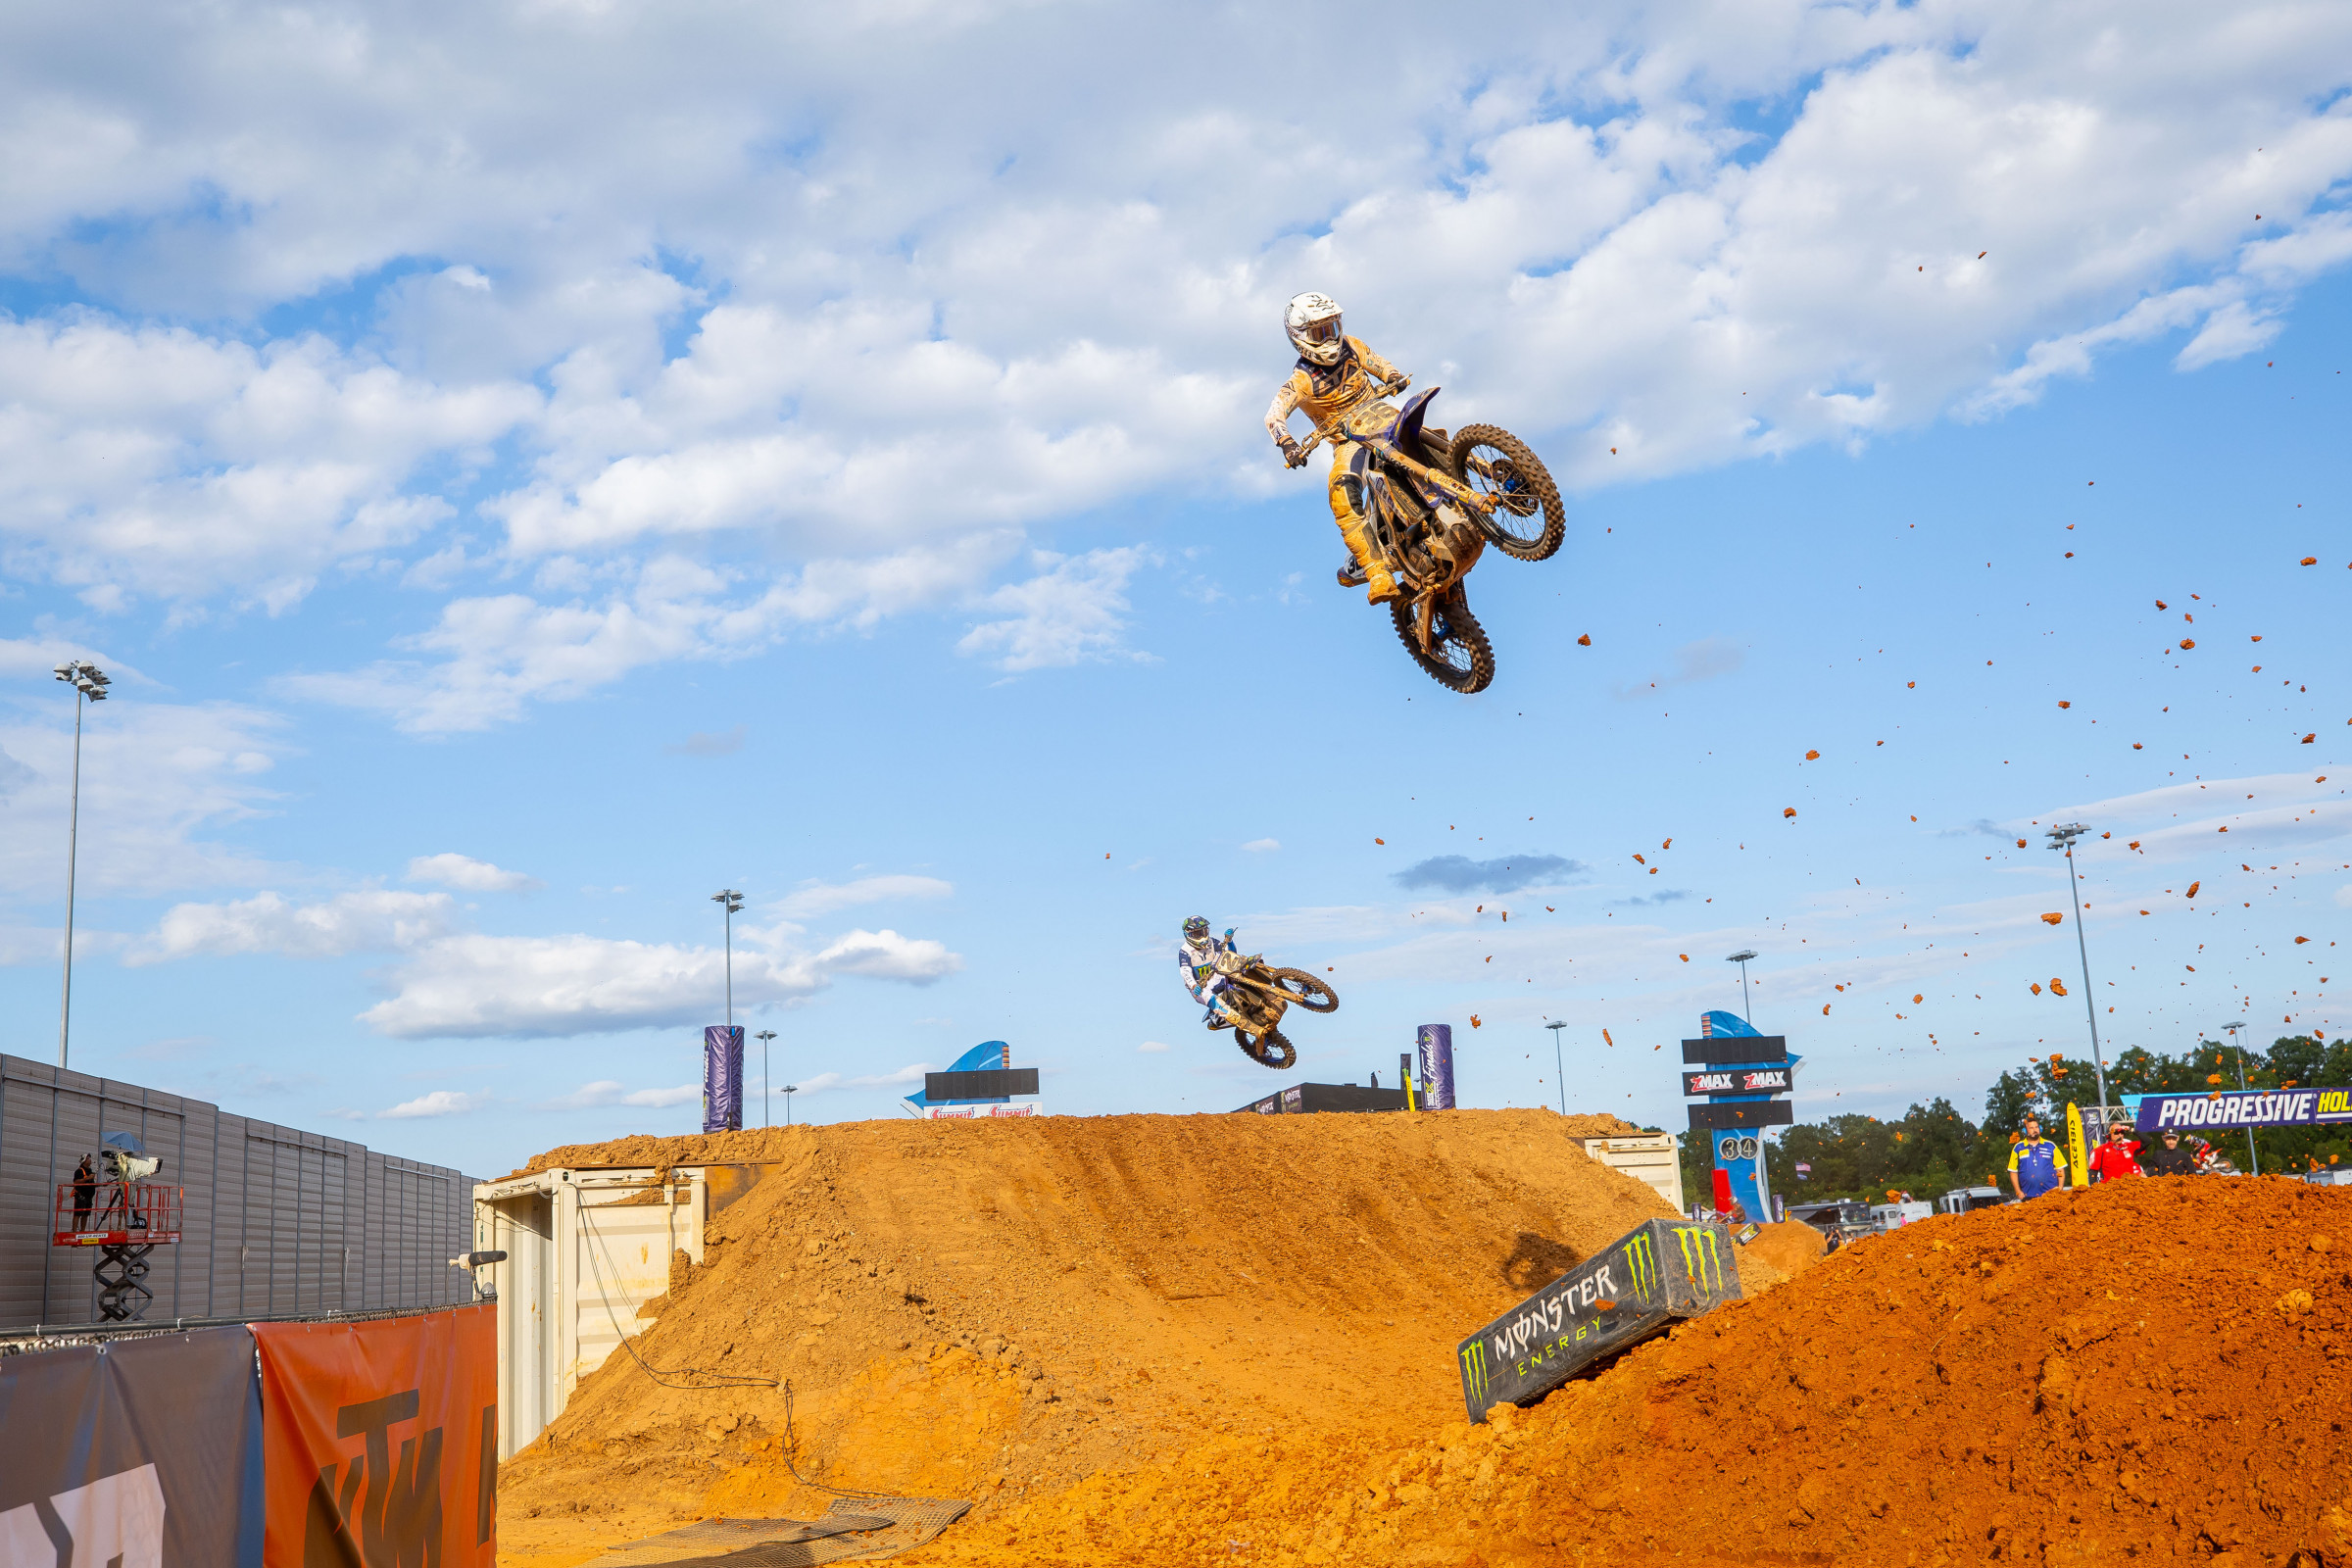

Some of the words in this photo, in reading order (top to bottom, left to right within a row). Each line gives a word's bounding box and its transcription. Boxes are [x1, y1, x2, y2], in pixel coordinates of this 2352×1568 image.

[2158, 1093, 2313, 1127] PROGRESSIVE
[2317, 1091, 2352, 1113] HOL
[2069, 1119, 2079, 1169] ACERBIS
[1494, 1263, 1619, 1361] MONSTER
[1517, 1316, 1601, 1377] ENERGY
